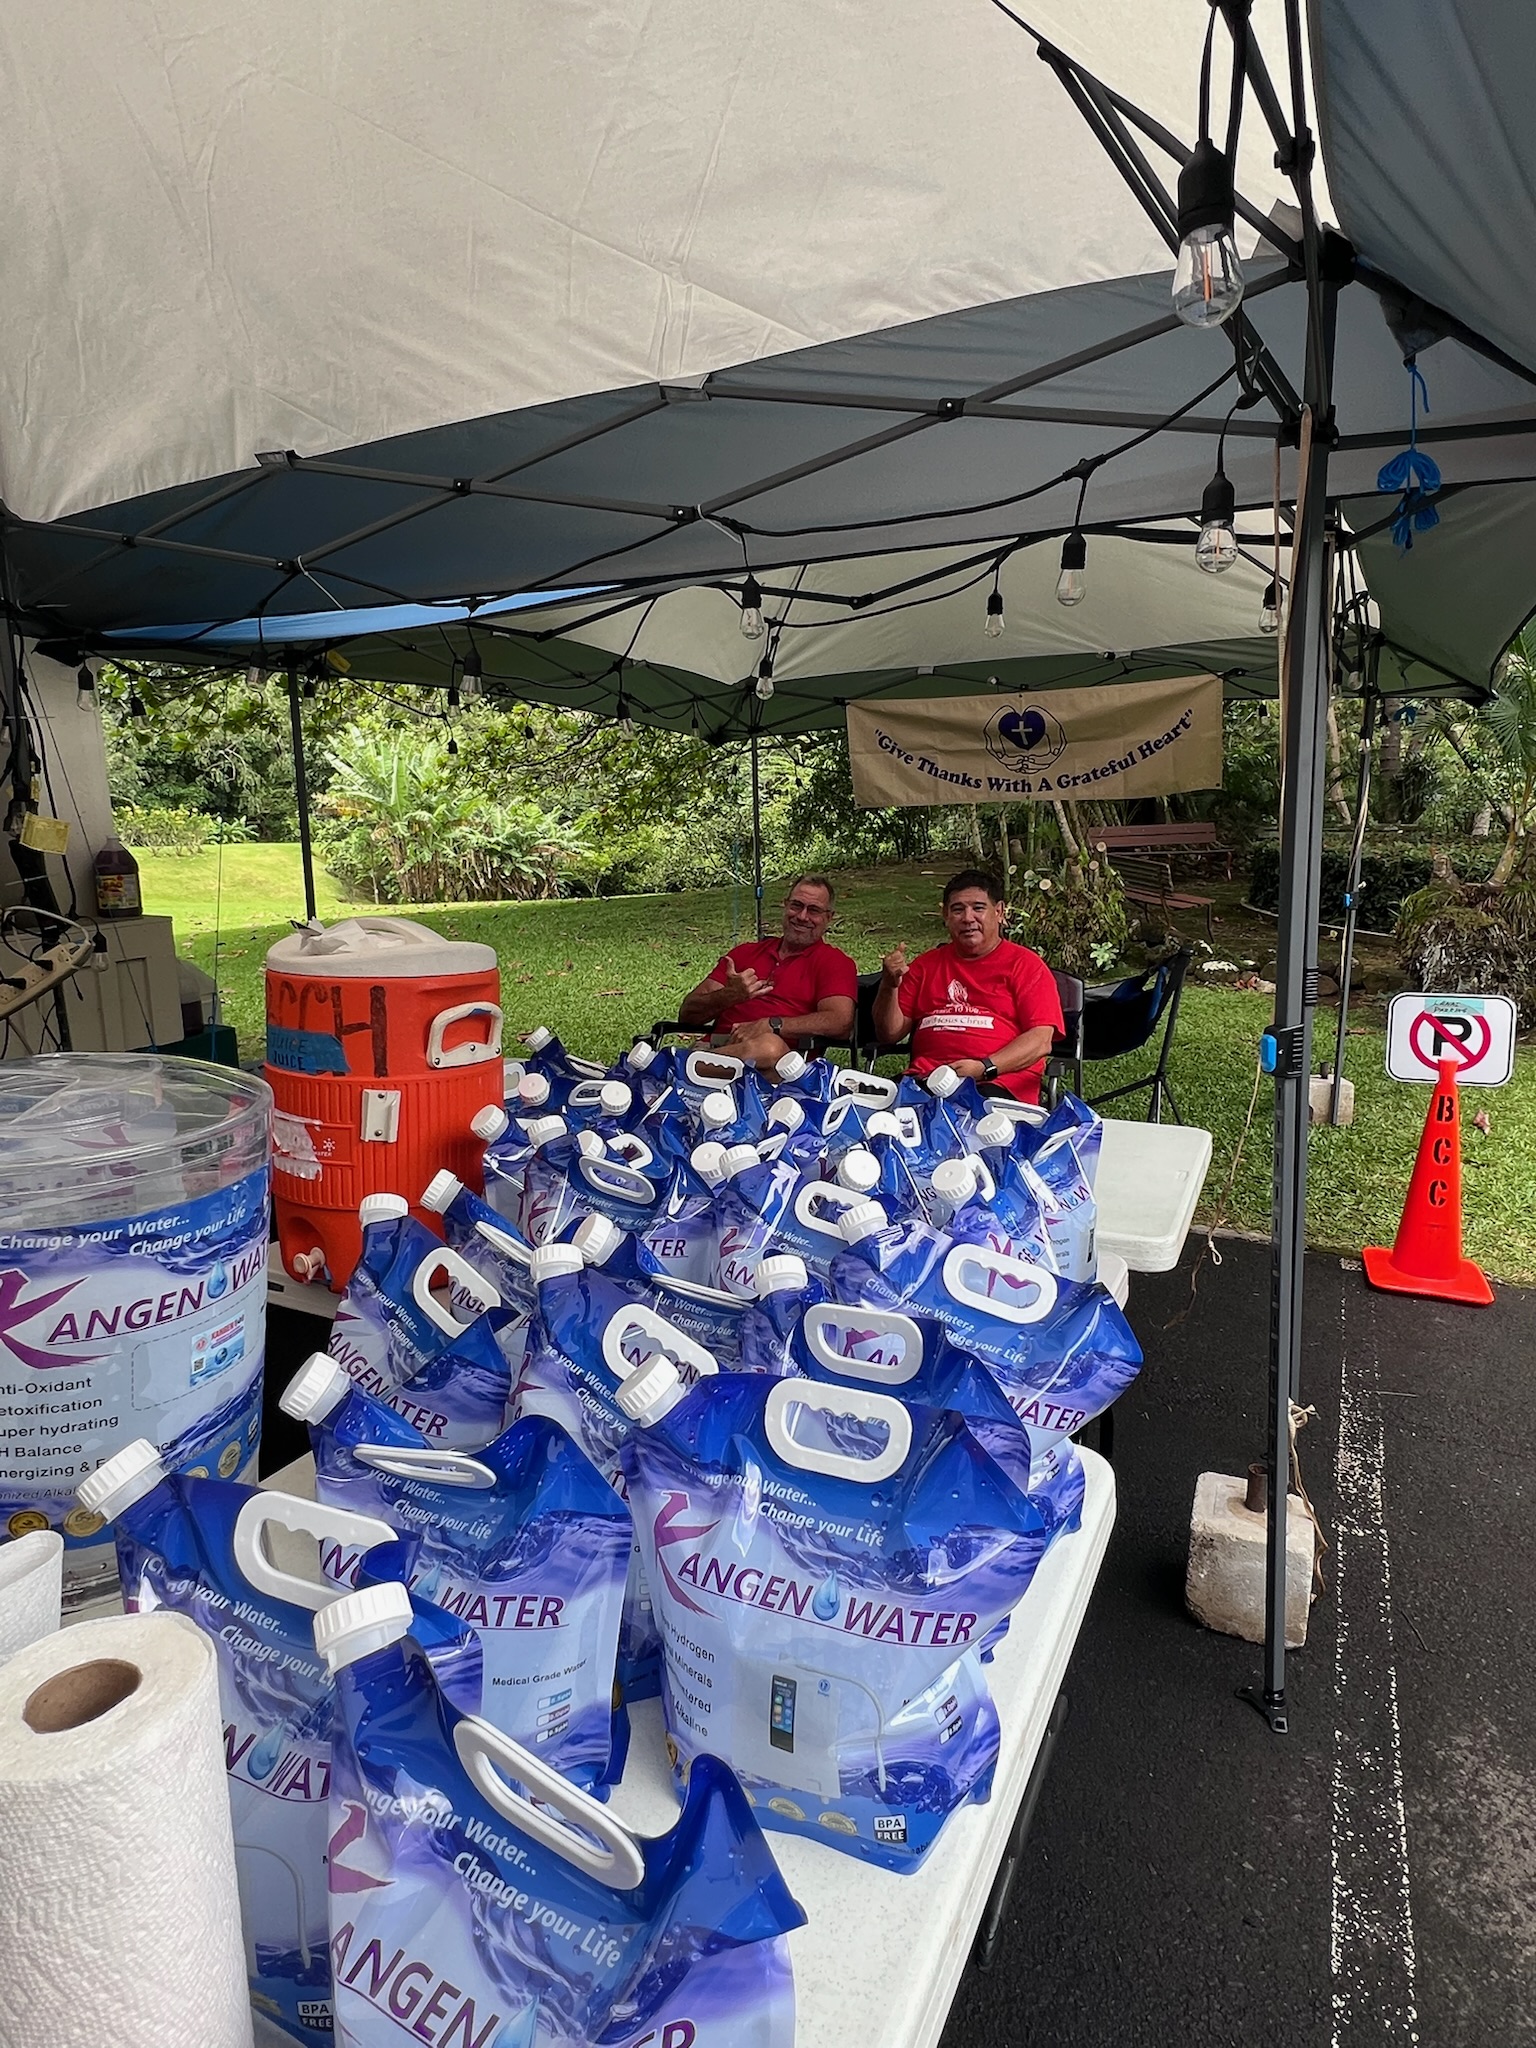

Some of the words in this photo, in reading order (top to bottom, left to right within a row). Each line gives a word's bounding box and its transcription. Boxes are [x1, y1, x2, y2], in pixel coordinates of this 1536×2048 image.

[874, 728, 914, 765] "Give
[917, 757, 982, 789] Thanks
[987, 776, 1032, 793] With
[1037, 777, 1053, 792] A
[1056, 751, 1138, 789] Grateful
[1136, 708, 1194, 760] Heart"
[273, 1050, 306, 1071] JUICE
[0, 1233, 73, 1251] Change
[78, 1227, 122, 1249] your
[127, 1215, 190, 1238] Water...
[129, 1230, 192, 1257] Change
[195, 1219, 227, 1242] your
[227, 1206, 246, 1227] Life
[372, 1289, 400, 1310] your
[394, 1304, 420, 1337] Water...
[670, 1312, 711, 1332] Change
[711, 1325, 735, 1336] your
[904, 1300, 932, 1315] your
[386, 1318, 414, 1351] Change
[974, 1340, 1003, 1356] your
[1003, 1347, 1028, 1364] Life
[555, 1353, 586, 1377] your
[387, 1395, 448, 1437] ATER
[575, 1387, 615, 1424] Change
[40, 1415, 119, 1438] hydrating
[15, 1443, 82, 1458] Balance
[79, 1461, 91, 1473] &
[369, 1468, 402, 1489] your
[402, 1480, 447, 1506] Water...
[762, 1479, 817, 1508] Water...
[392, 1498, 439, 1525] Change
[438, 1514, 469, 1533] your
[468, 1519, 493, 1541] Life
[757, 1501, 816, 1530] Change
[815, 1518, 855, 1541] your
[855, 1520, 885, 1548] Life
[191, 1582, 232, 1611] your
[232, 1599, 288, 1638] Water...
[843, 1597, 979, 1645] WATER
[218, 1624, 282, 1664] Change
[276, 1653, 320, 1679] your
[670, 1623, 715, 1664] Hydrogen
[491, 1675, 530, 1687] Medical
[532, 1671, 562, 1684] Grade
[562, 1658, 588, 1677] Water
[674, 1650, 713, 1689] Minerals
[877, 1818, 902, 1830] BPA
[877, 1831, 905, 1842] FREE
[464, 1816, 537, 1876] Water...
[453, 1851, 529, 1912] Change
[523, 1900, 581, 1942] your
[581, 1928, 622, 1970] Life
[302, 2003, 330, 2014] BPA
[302, 2016, 333, 2028] FREE
